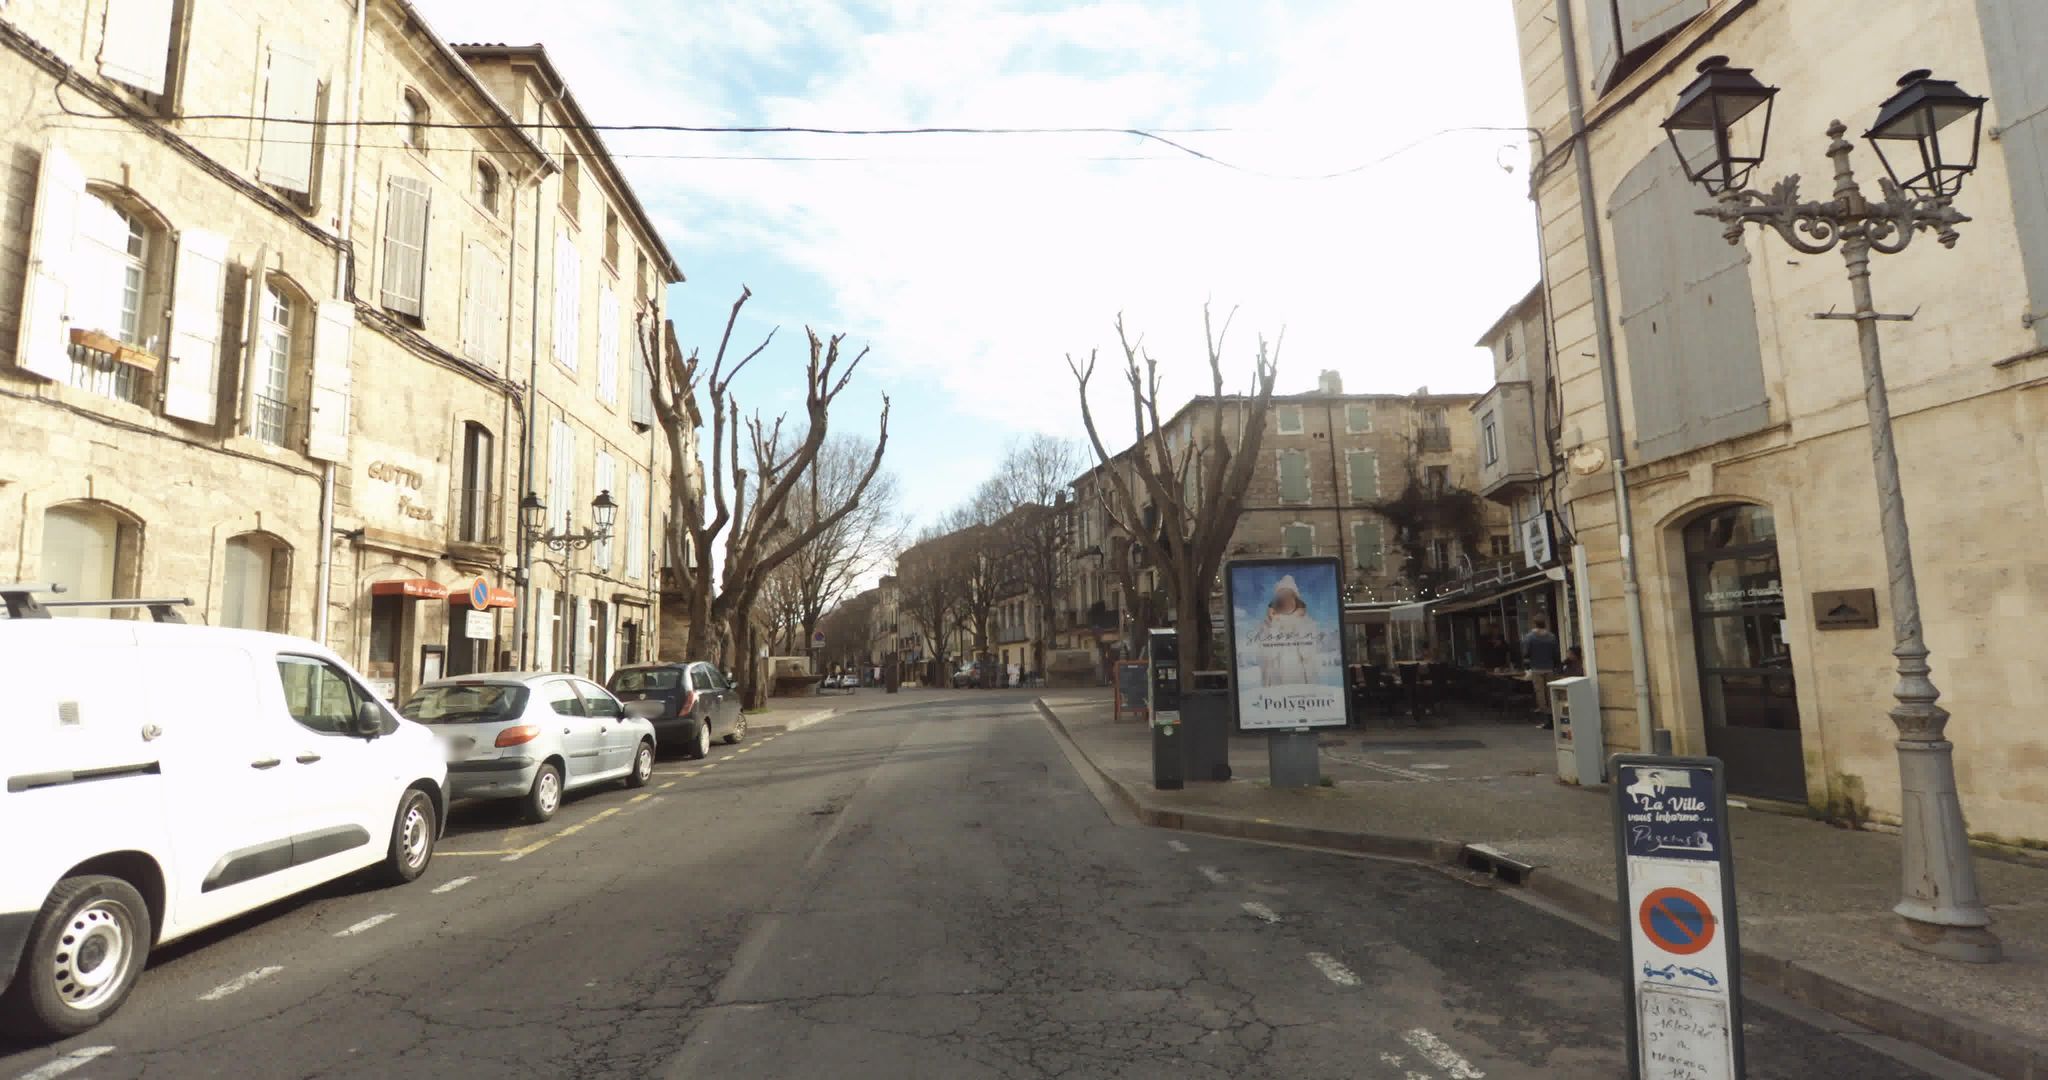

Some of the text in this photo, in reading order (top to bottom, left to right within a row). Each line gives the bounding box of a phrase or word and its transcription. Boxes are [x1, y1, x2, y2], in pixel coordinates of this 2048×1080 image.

[1264, 696, 1335, 712] Polygone
[1641, 796, 1706, 812] La Ville
[1627, 813, 1653, 823] vous
[1655, 811, 1700, 824] informe
